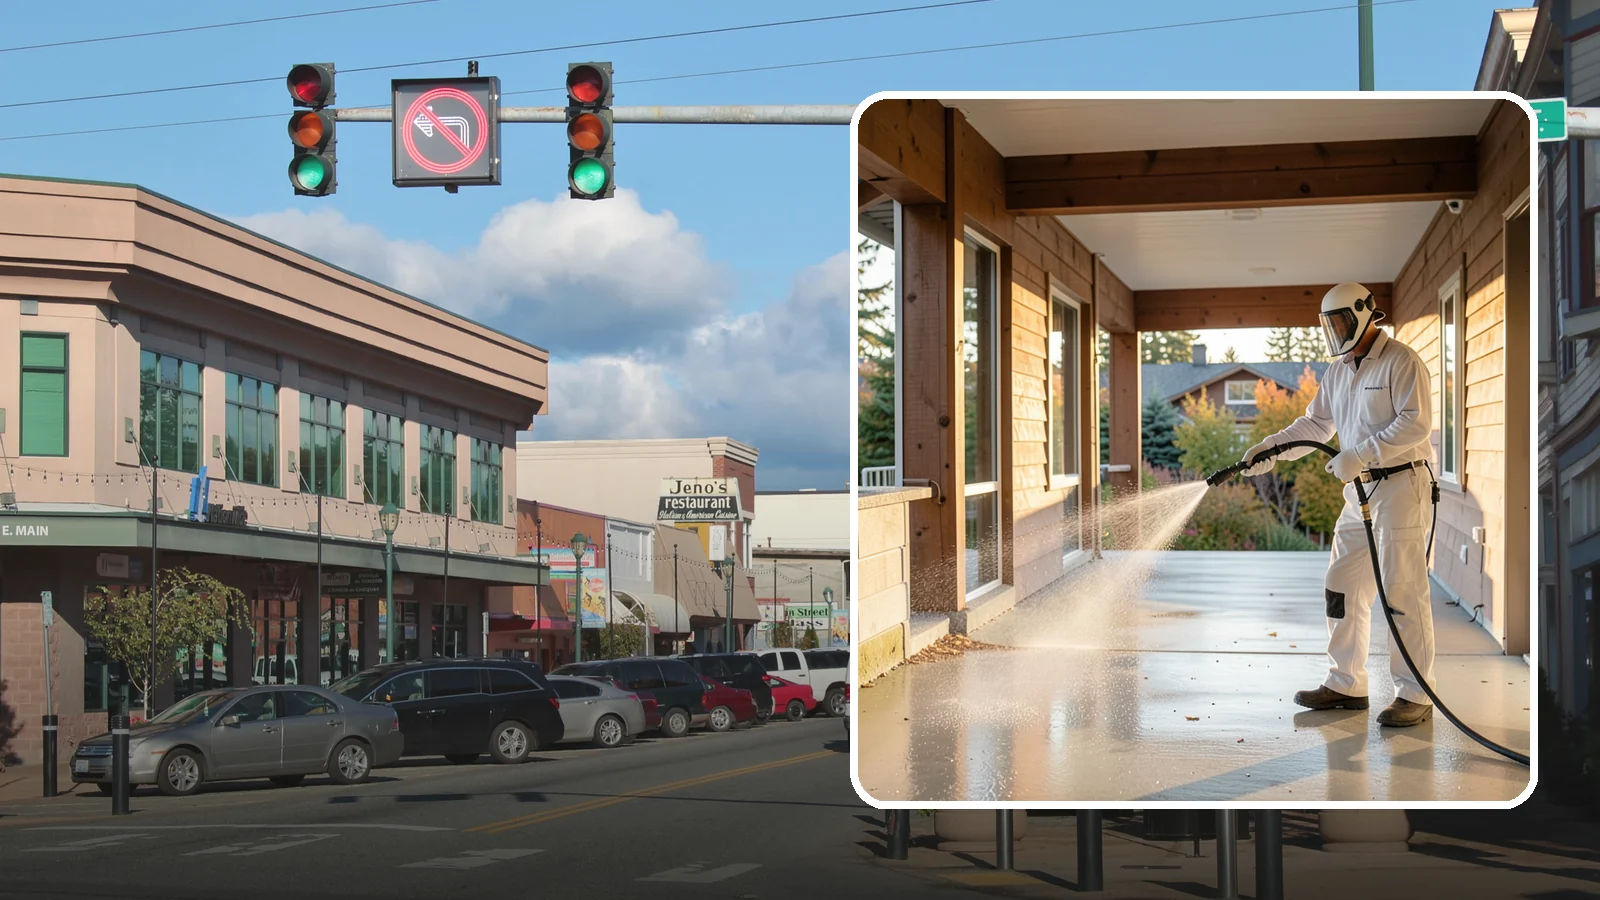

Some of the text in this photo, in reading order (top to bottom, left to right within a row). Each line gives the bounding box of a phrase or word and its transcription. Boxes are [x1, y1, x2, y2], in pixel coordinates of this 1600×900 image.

[669, 480, 728, 495] Jeno's
[665, 496, 731, 509] restaurant
[685, 510, 714, 520] American
[715, 510, 738, 520] Cuisine
[2, 525, 49, 536] E. MAIN
[797, 607, 828, 617] Street
